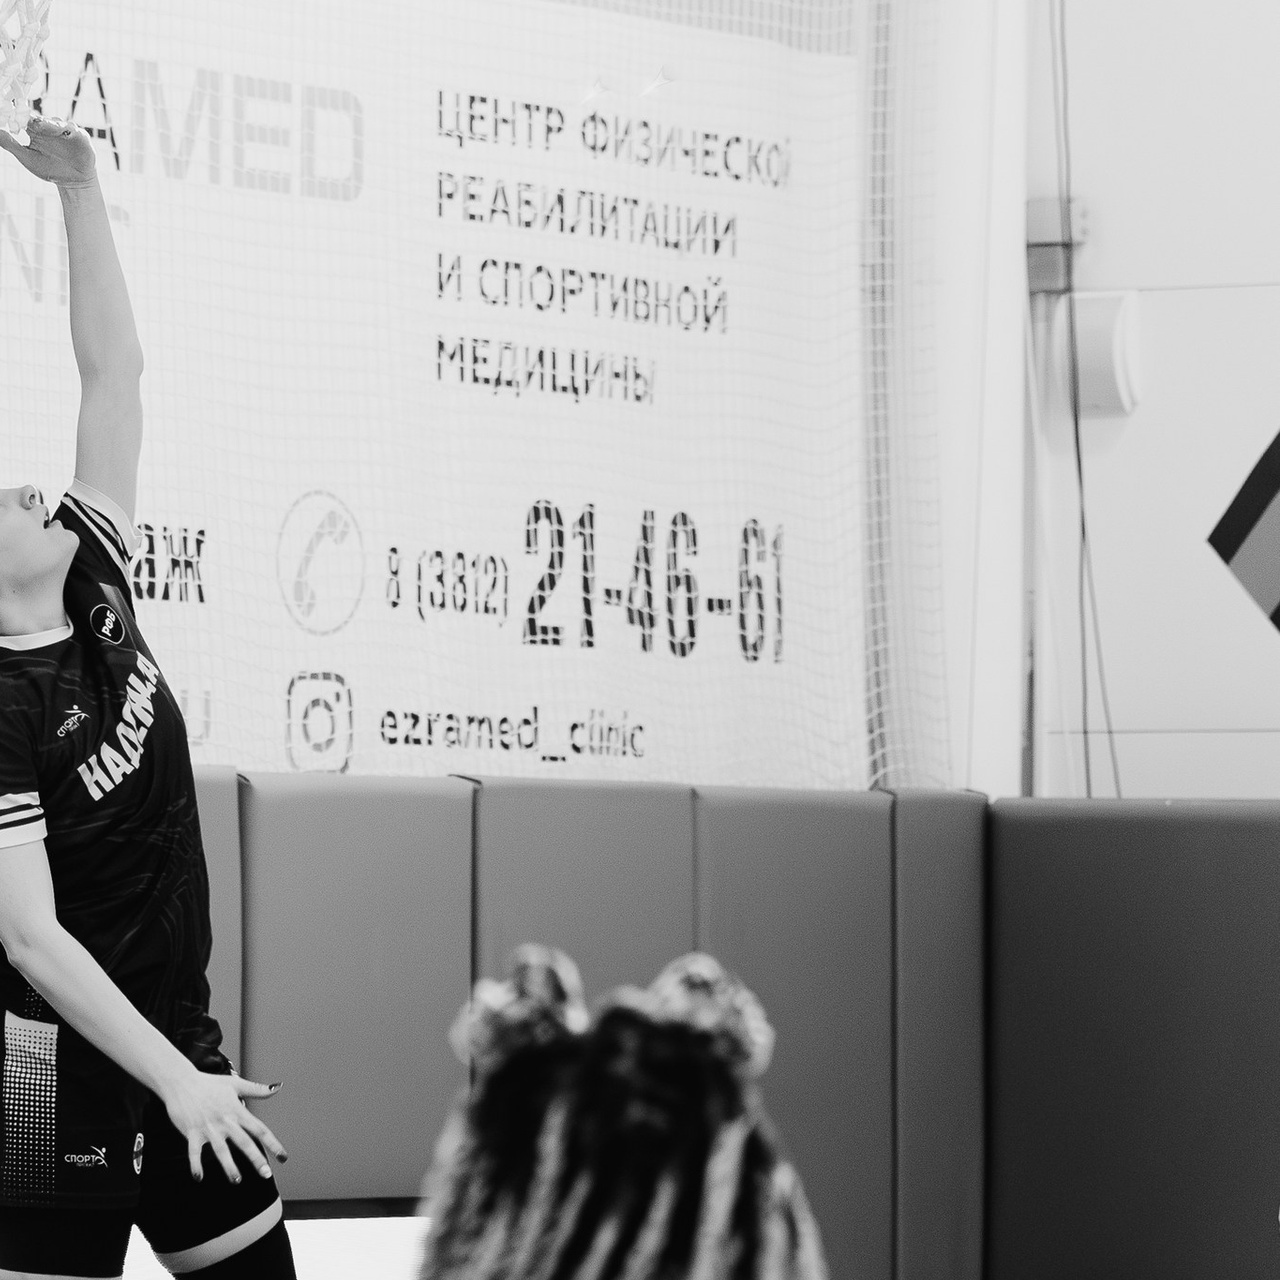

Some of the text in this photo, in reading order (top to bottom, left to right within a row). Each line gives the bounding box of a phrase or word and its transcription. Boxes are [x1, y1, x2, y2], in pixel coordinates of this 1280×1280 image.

[437, 90, 565, 150] ЦЕНТР
[436, 171, 739, 259] РЕАБИЛИТАЦИИ
[437, 252, 729, 335] И СПОРТИВНОЙ
[436, 334, 657, 406] МЕДИЦИНЫ
[384, 499, 786, 664] 8 (3812) 21-46-61
[379, 705, 645, 763] ezramed_clinic
